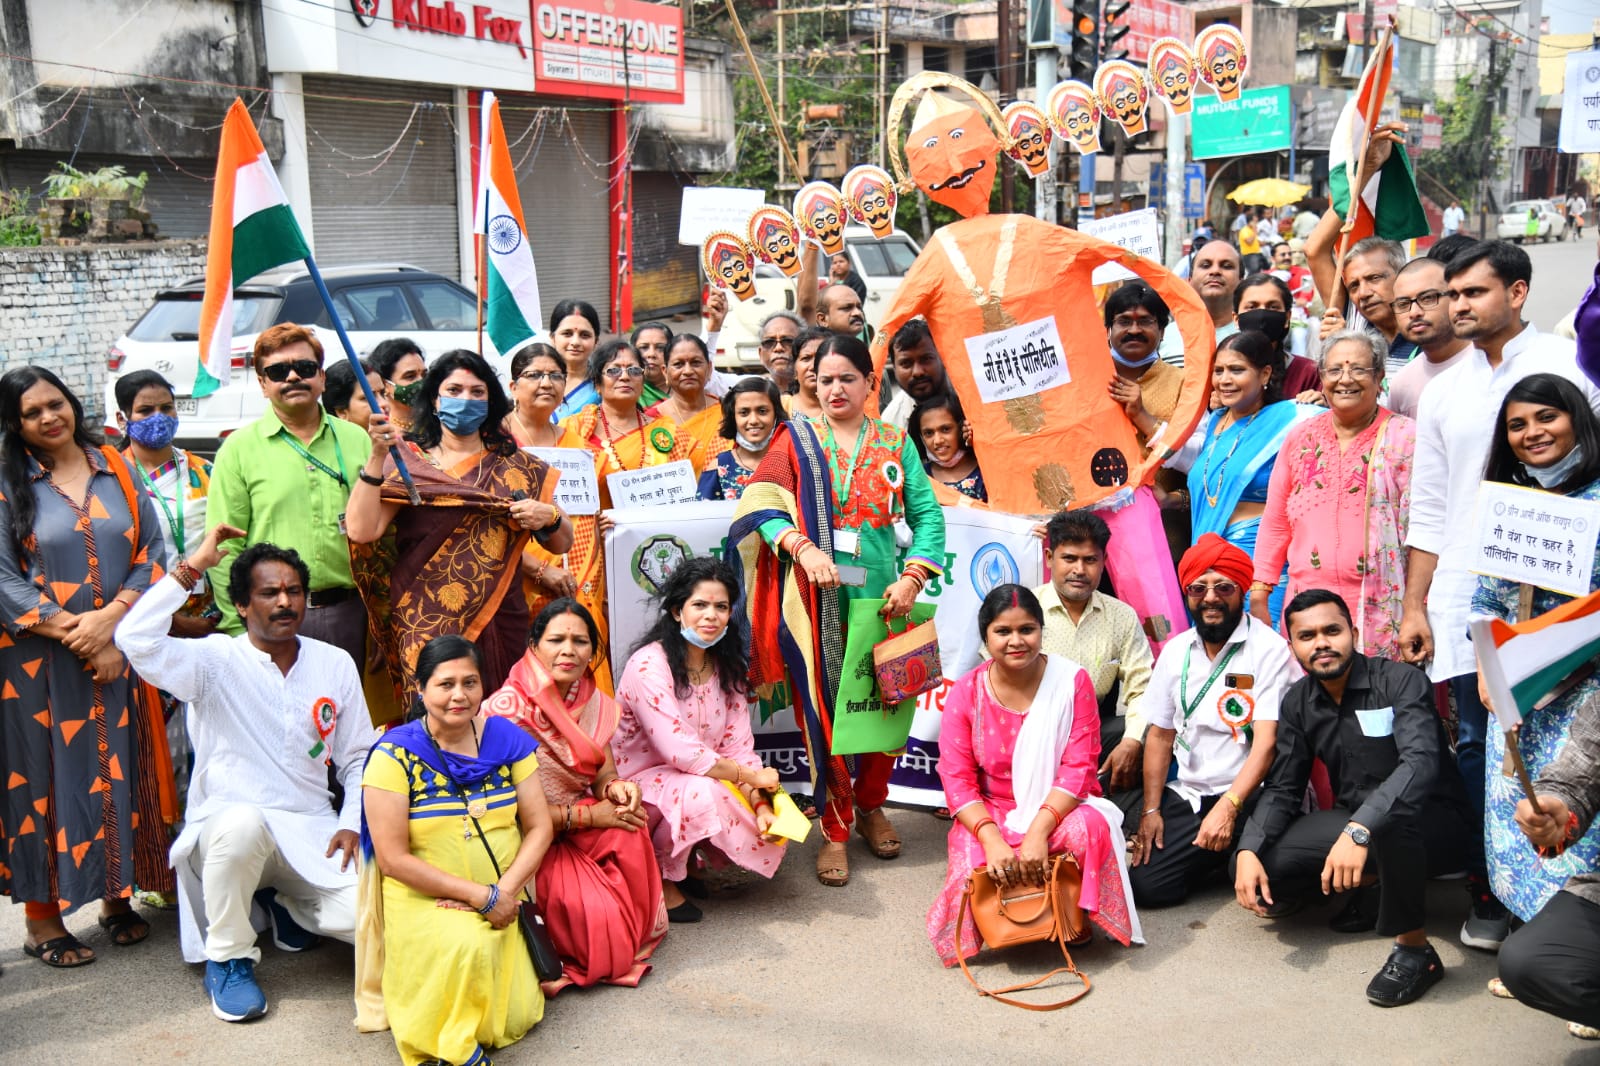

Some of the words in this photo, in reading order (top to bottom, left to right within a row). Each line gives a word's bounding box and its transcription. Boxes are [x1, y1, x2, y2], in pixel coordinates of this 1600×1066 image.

[391, 0, 466, 37] Klub
[473, 5, 527, 59] Fox
[1197, 102, 1239, 116] MUTUAL
[1242, 95, 1278, 109] FUNDS
[983, 352, 997, 383] जी
[639, 492, 653, 501] माता
[667, 486, 683, 498] पुकार
[1508, 530, 1522, 543] वंश
[1526, 535, 1538, 548] पर
[1542, 538, 1562, 553] कहर
[1483, 544, 1519, 563] पॉलिथीन
[1522, 555, 1537, 568] एक
[1542, 559, 1562, 573] जहर
